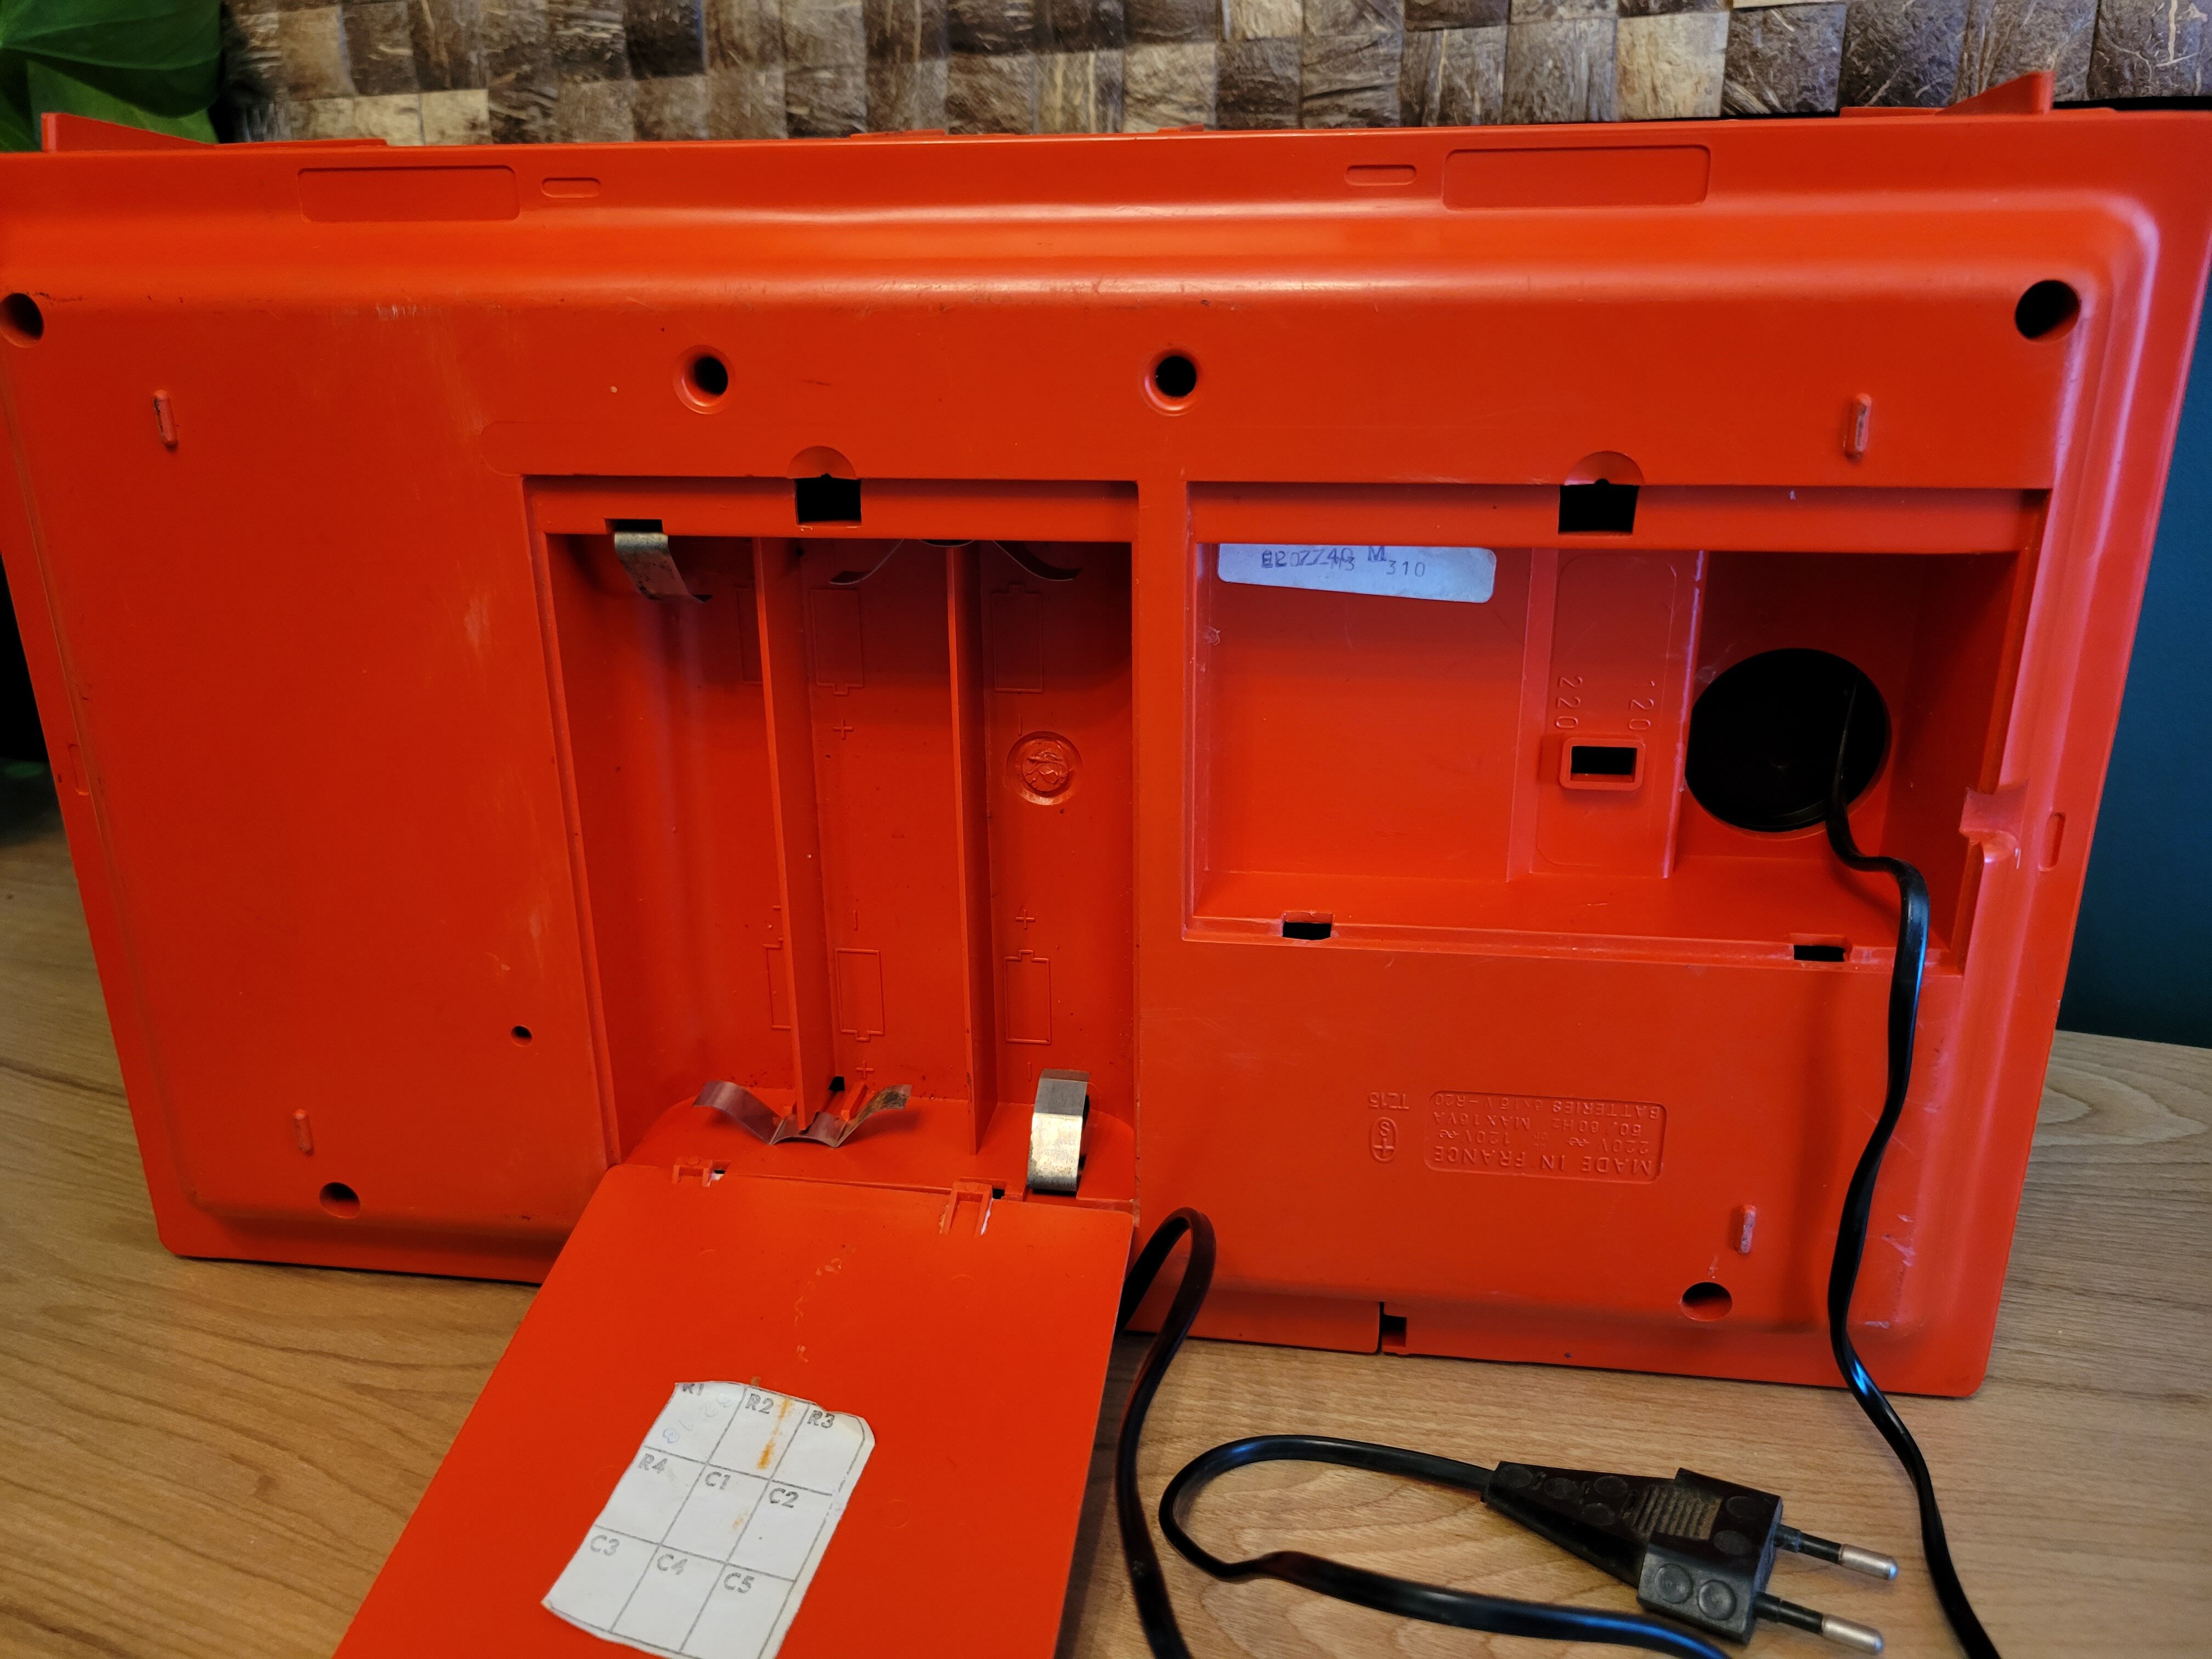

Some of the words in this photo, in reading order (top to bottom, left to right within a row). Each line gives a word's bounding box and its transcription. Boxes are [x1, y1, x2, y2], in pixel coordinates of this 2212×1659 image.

[1555, 676, 1583, 729] 220
[1551, 1101, 1661, 1120] BATTERIES
[1434, 1145, 1525, 1167] FRANCE
[1541, 1154, 1564, 1171] IN
[1581, 1155, 1654, 1176] MADE
[745, 1392, 775, 1415] R2
[806, 1409, 836, 1429] R3
[637, 1453, 668, 1475] R4
[704, 1470, 732, 1490] C1
[769, 1487, 799, 1509] C2
[590, 1534, 620, 1556] C3
[657, 1554, 688, 1575] C4
[723, 1571, 755, 1594] C5
